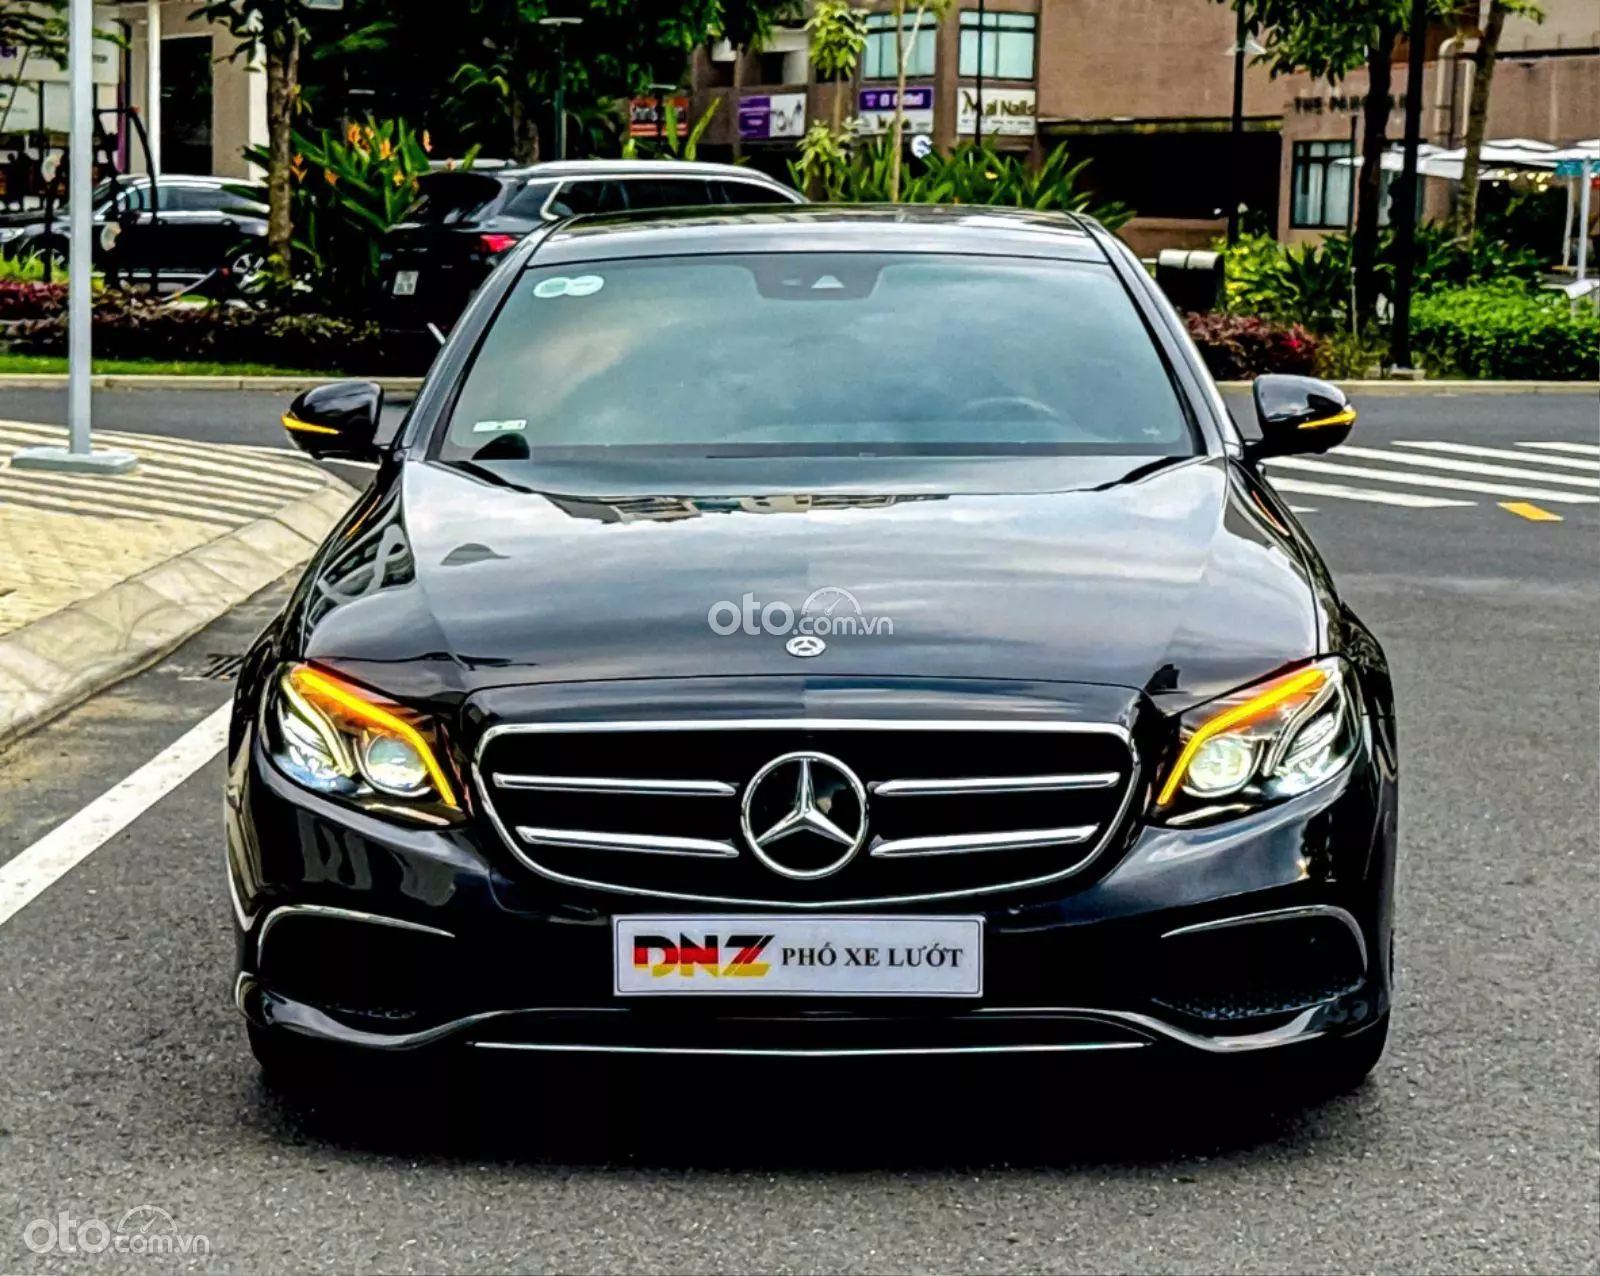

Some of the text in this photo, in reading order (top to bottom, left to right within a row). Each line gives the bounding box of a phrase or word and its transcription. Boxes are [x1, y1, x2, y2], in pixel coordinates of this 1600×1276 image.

[634, 932, 963, 977] DNZ PHỐ XE LƯỚT
